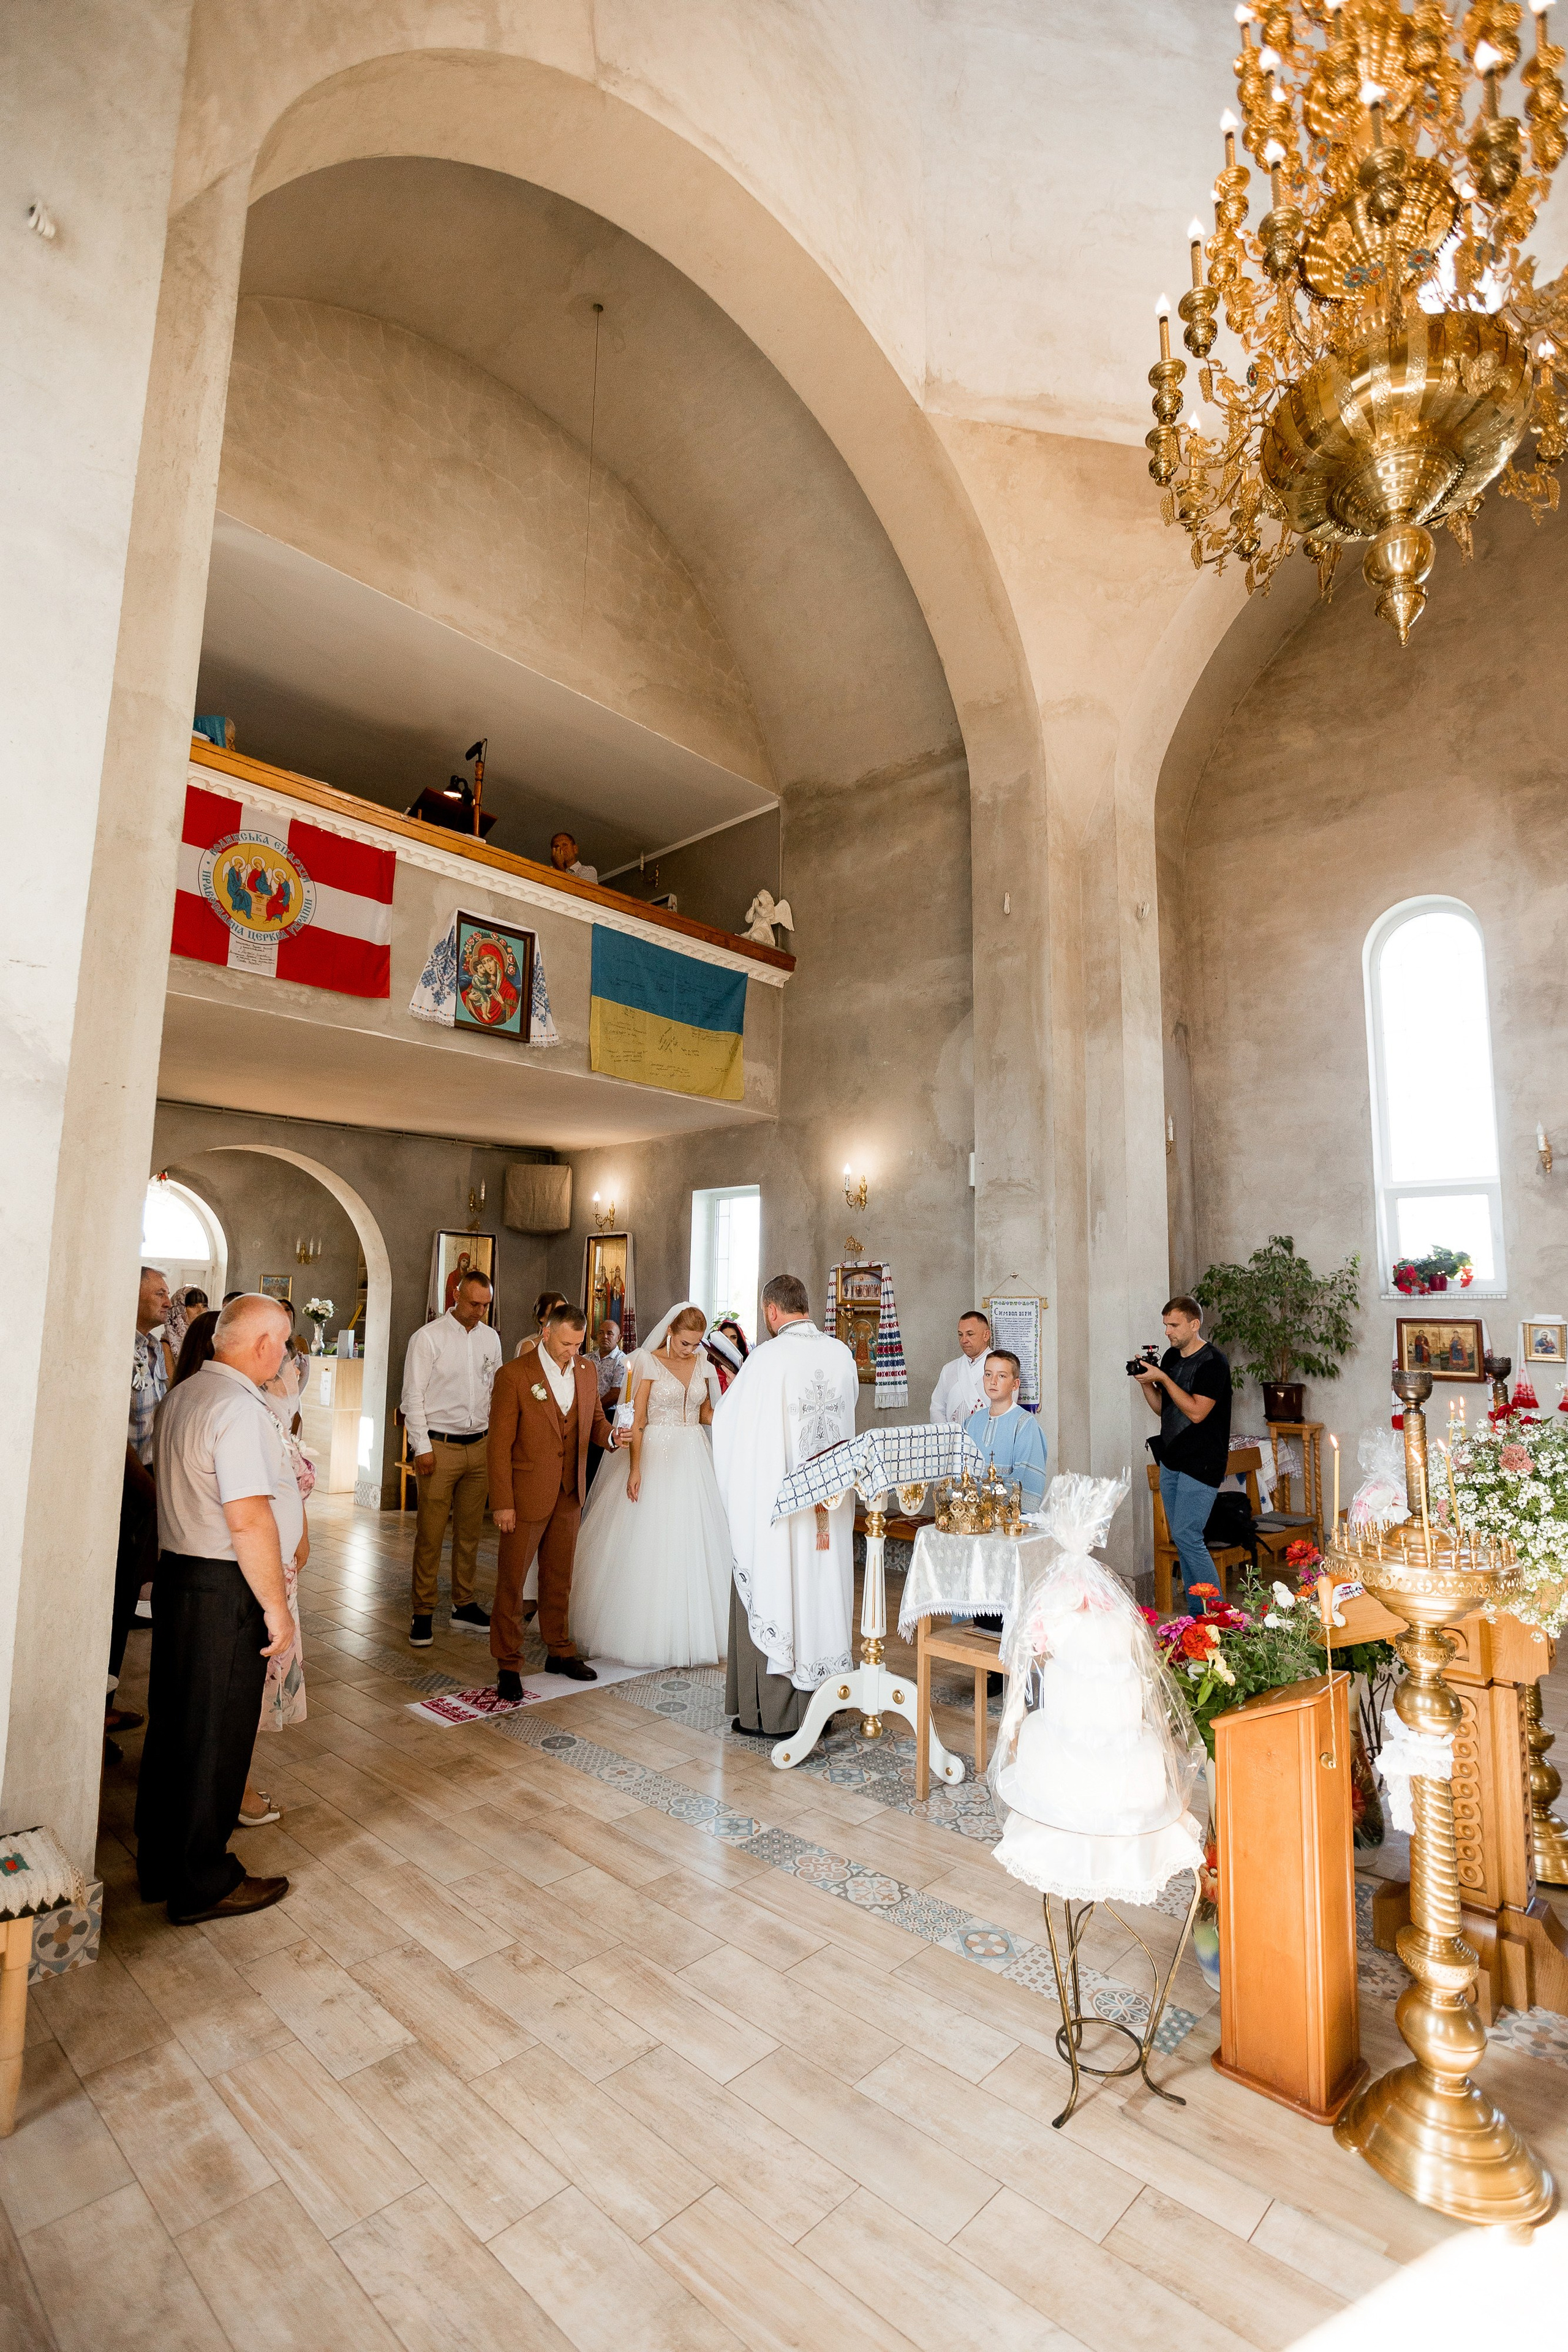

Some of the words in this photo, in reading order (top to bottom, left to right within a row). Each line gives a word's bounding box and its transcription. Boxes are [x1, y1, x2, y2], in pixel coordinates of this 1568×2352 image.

[209, 832, 269, 856] ВОЛИНСЬКА
[202, 870, 244, 935] ПРАВОСЛАВНА
[247, 930, 289, 941] ЦЕРКВА
[287, 899, 312, 936] УКРАЇНИ
